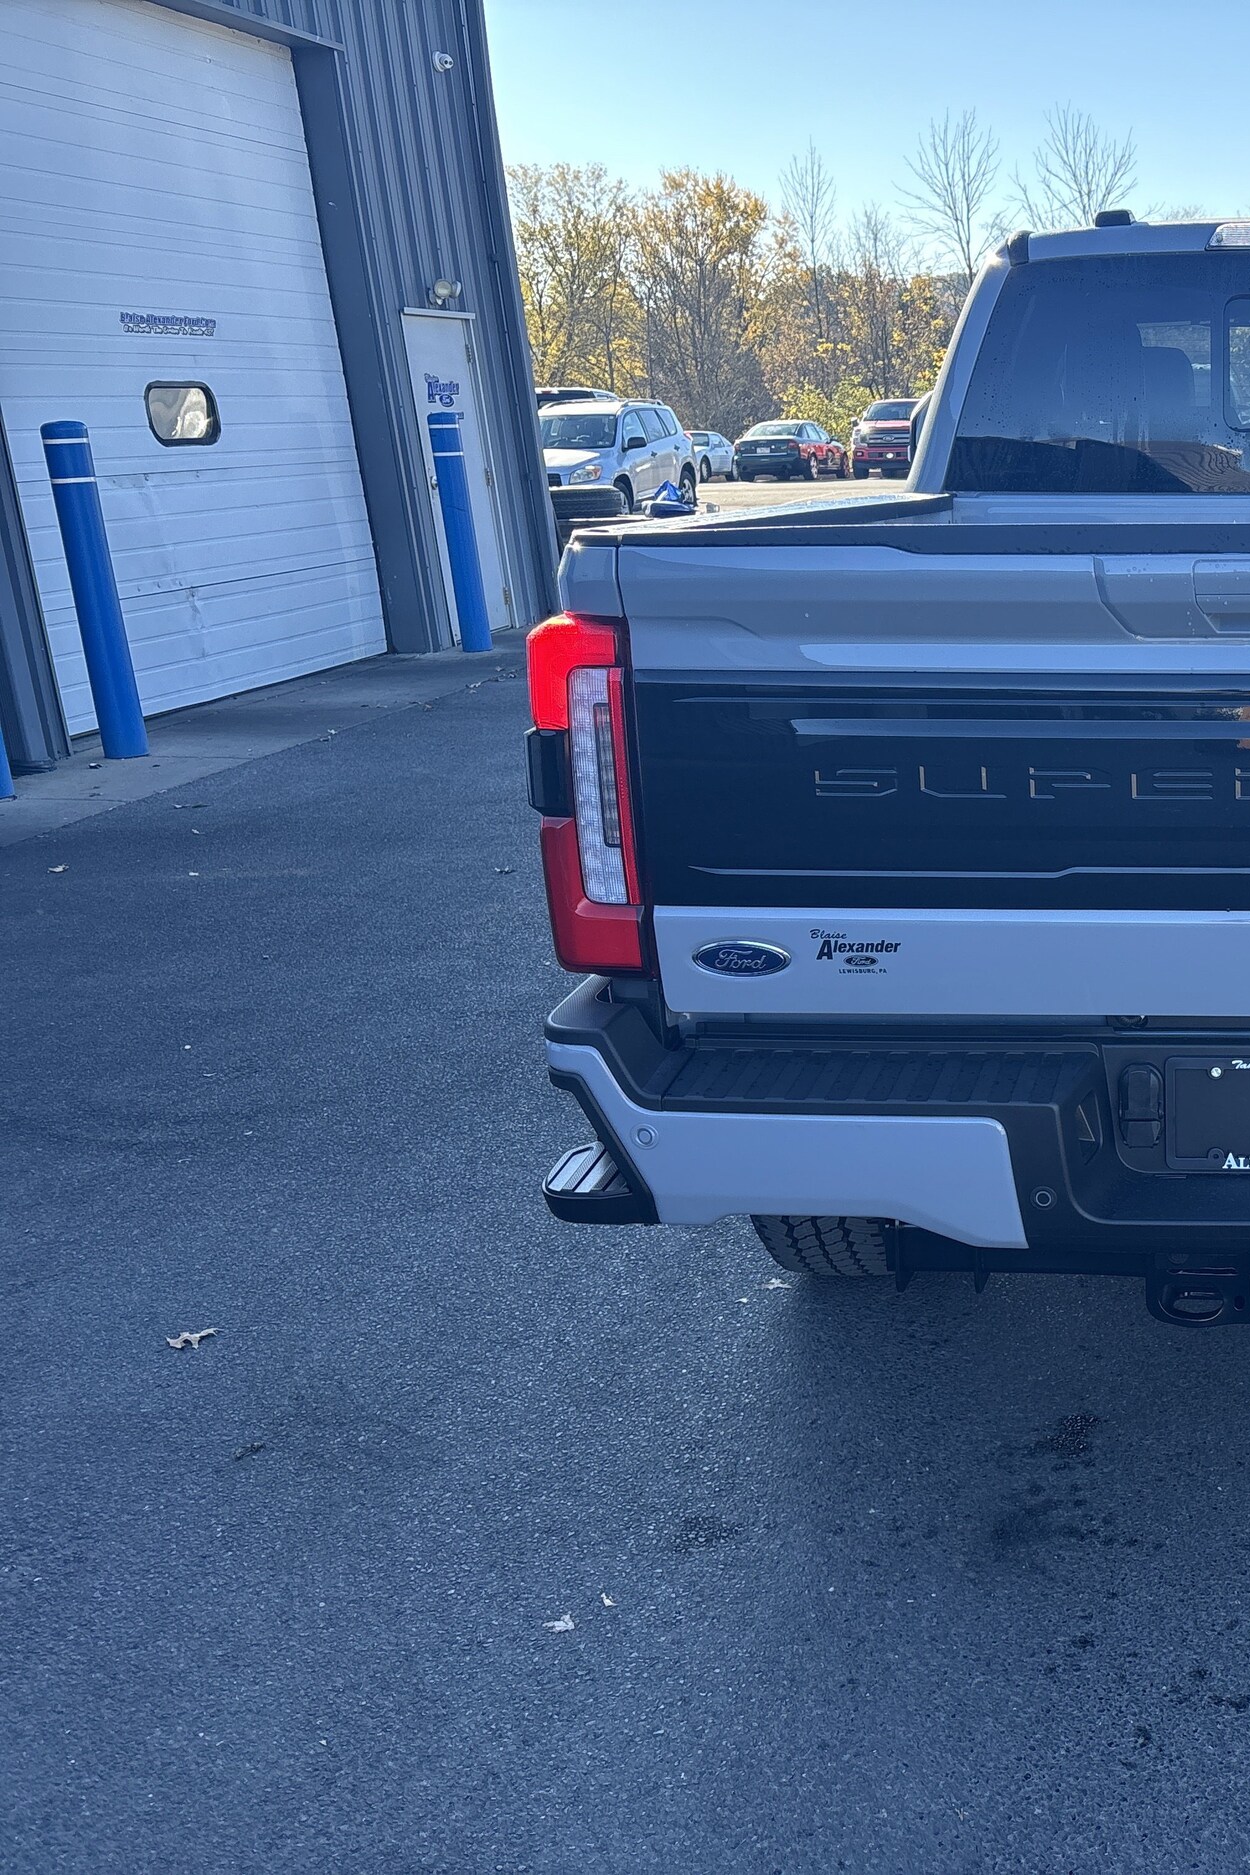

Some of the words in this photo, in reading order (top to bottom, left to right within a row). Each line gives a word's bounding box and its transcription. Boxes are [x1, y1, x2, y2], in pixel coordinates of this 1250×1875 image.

[810, 928, 847, 940] Blaise
[714, 948, 768, 970] Ford
[816, 940, 901, 960] Alexander
